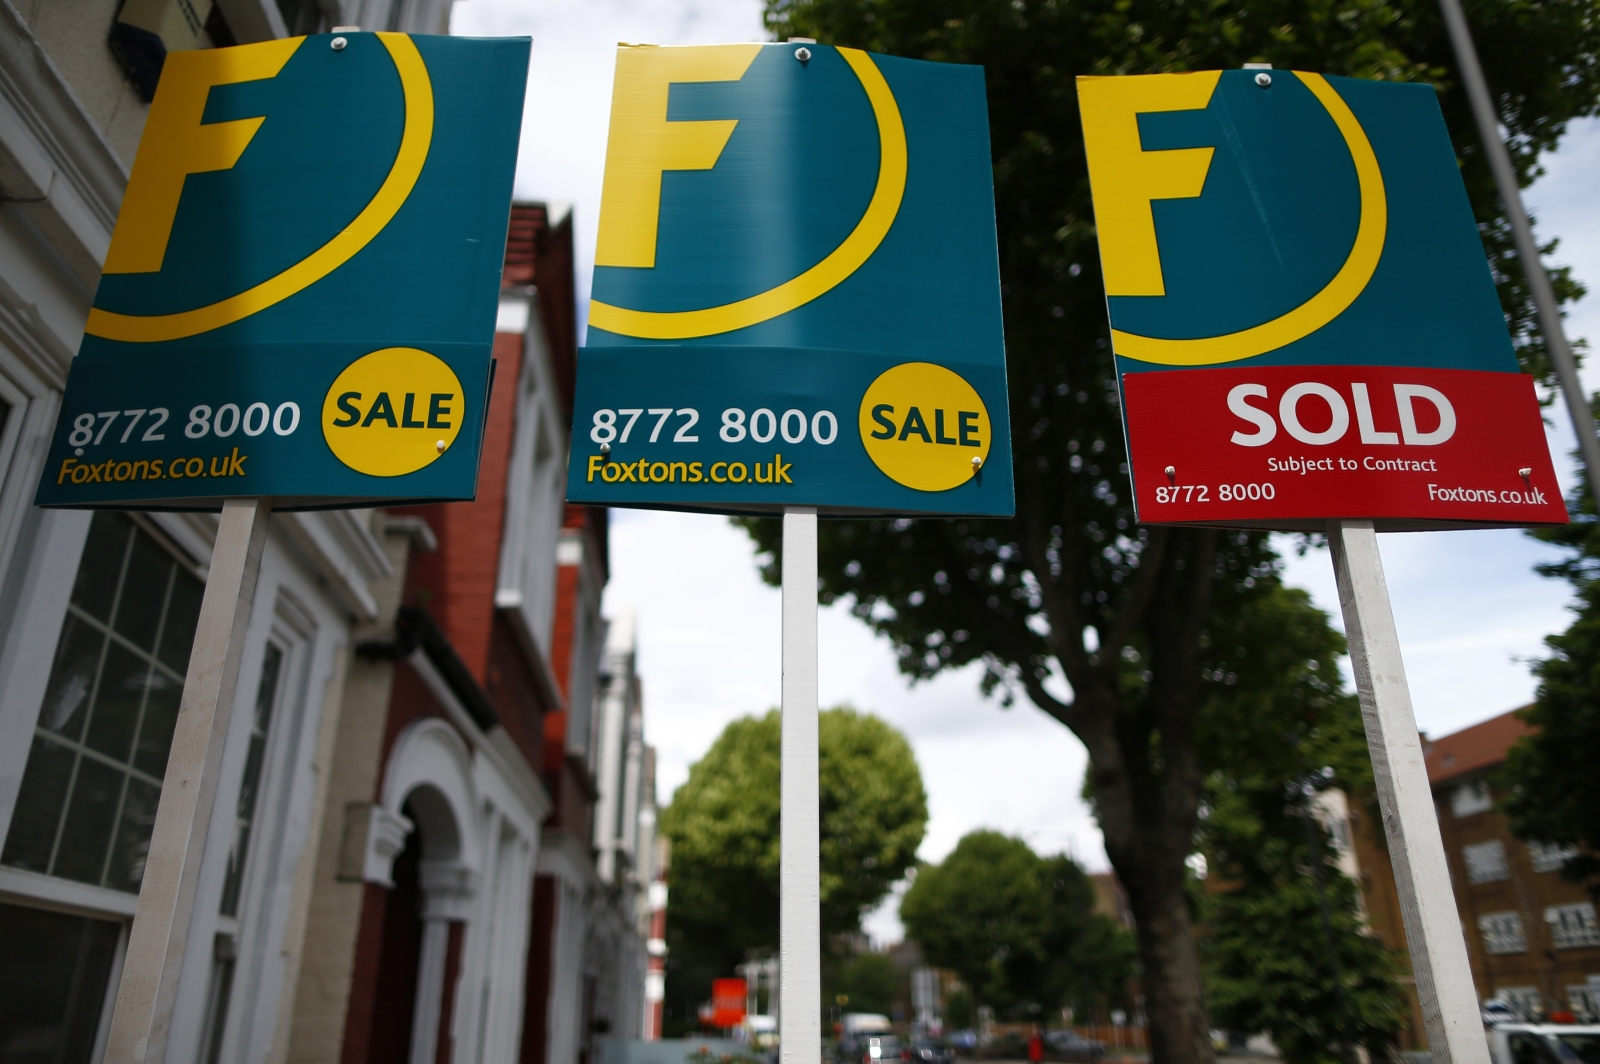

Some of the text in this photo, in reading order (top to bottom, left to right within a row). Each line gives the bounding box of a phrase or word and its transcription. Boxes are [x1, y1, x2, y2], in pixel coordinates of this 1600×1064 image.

[68, 401, 301, 448] 8772 8000
[332, 391, 455, 430] SALE
[589, 407, 839, 446] 8772 8000
[870, 403, 982, 448] SALE
[1226, 381, 1457, 447] SOLD
[57, 448, 248, 485] Foxtons.co.uk
[587, 453, 793, 484] Foxtons.co.uk
[1267, 456, 1438, 475] Subject to Contract
[1155, 482, 1276, 504] 8772 8000
[1427, 483, 1549, 506] Foxtons.co.uk
